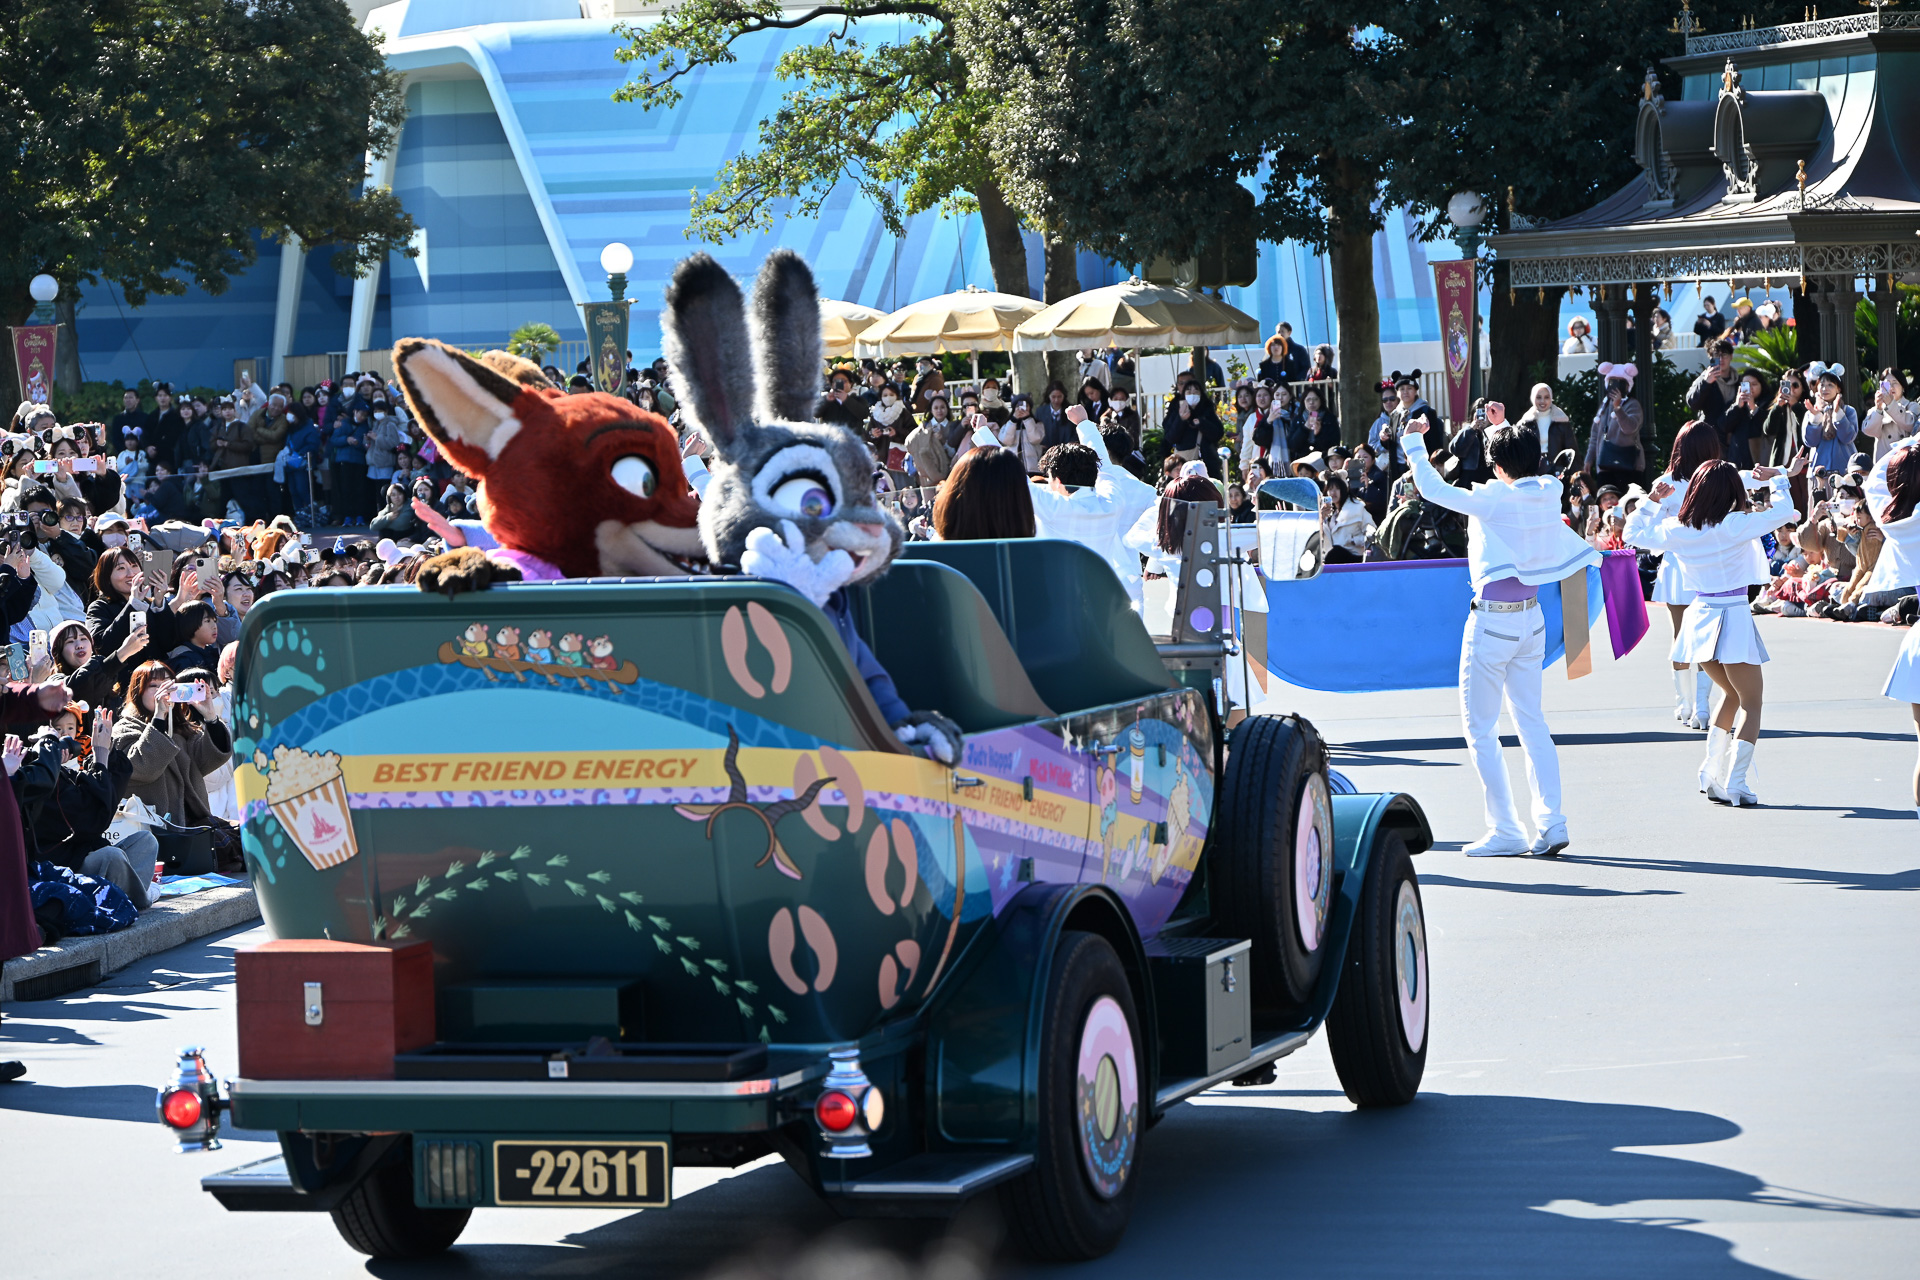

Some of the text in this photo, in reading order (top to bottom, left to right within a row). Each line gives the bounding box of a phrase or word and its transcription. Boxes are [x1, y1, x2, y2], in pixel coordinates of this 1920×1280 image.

[372, 758, 698, 783] BEST FRIEND ENERGY
[964, 786, 1066, 822] BEST FRIEND ENERGY
